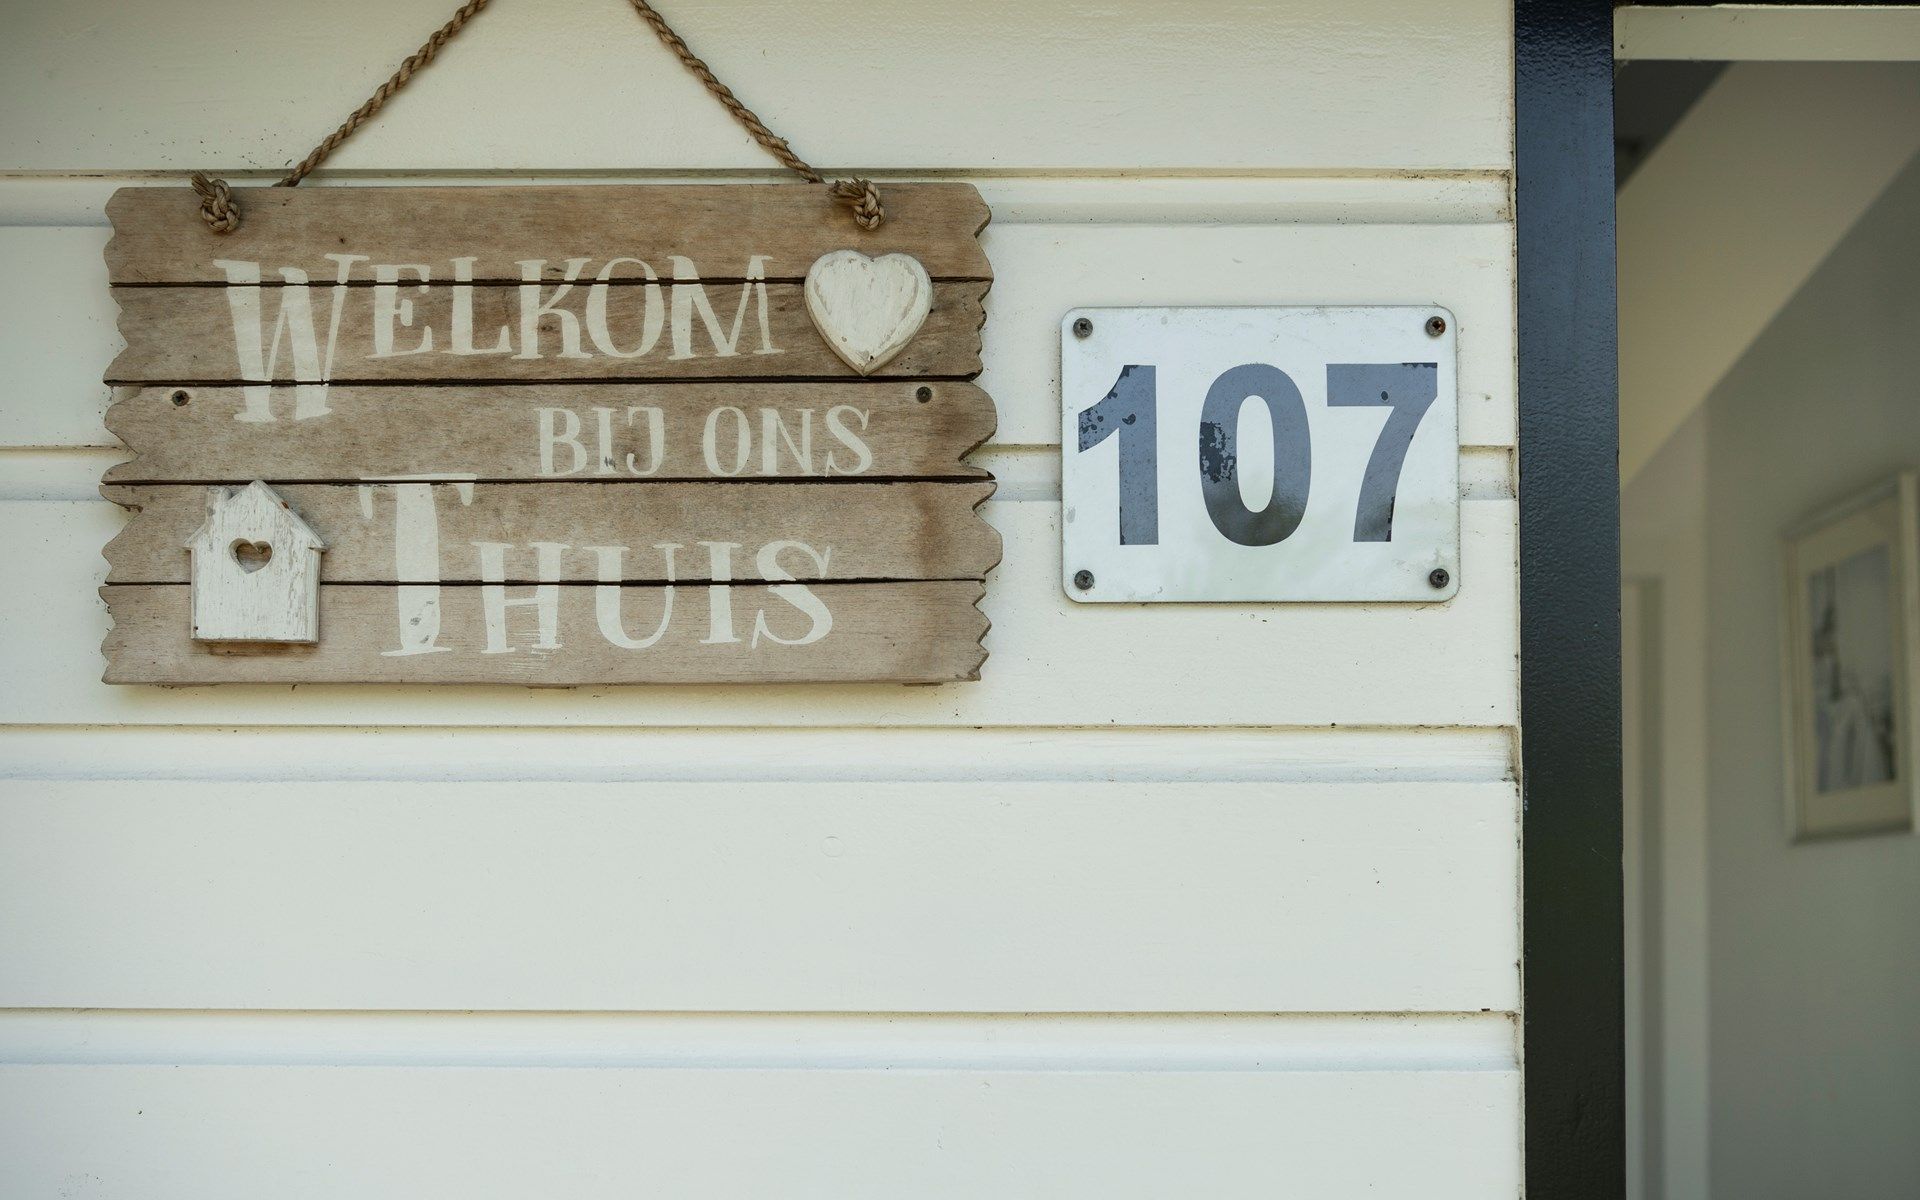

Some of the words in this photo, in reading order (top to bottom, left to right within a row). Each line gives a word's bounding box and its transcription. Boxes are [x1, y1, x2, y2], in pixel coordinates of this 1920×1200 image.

[213, 252, 785, 424] WELKOM
[536, 405, 667, 478] BIJ
[702, 404, 873, 479] ONS
[1078, 362, 1439, 547] 107
[357, 472, 836, 658] THUIS
